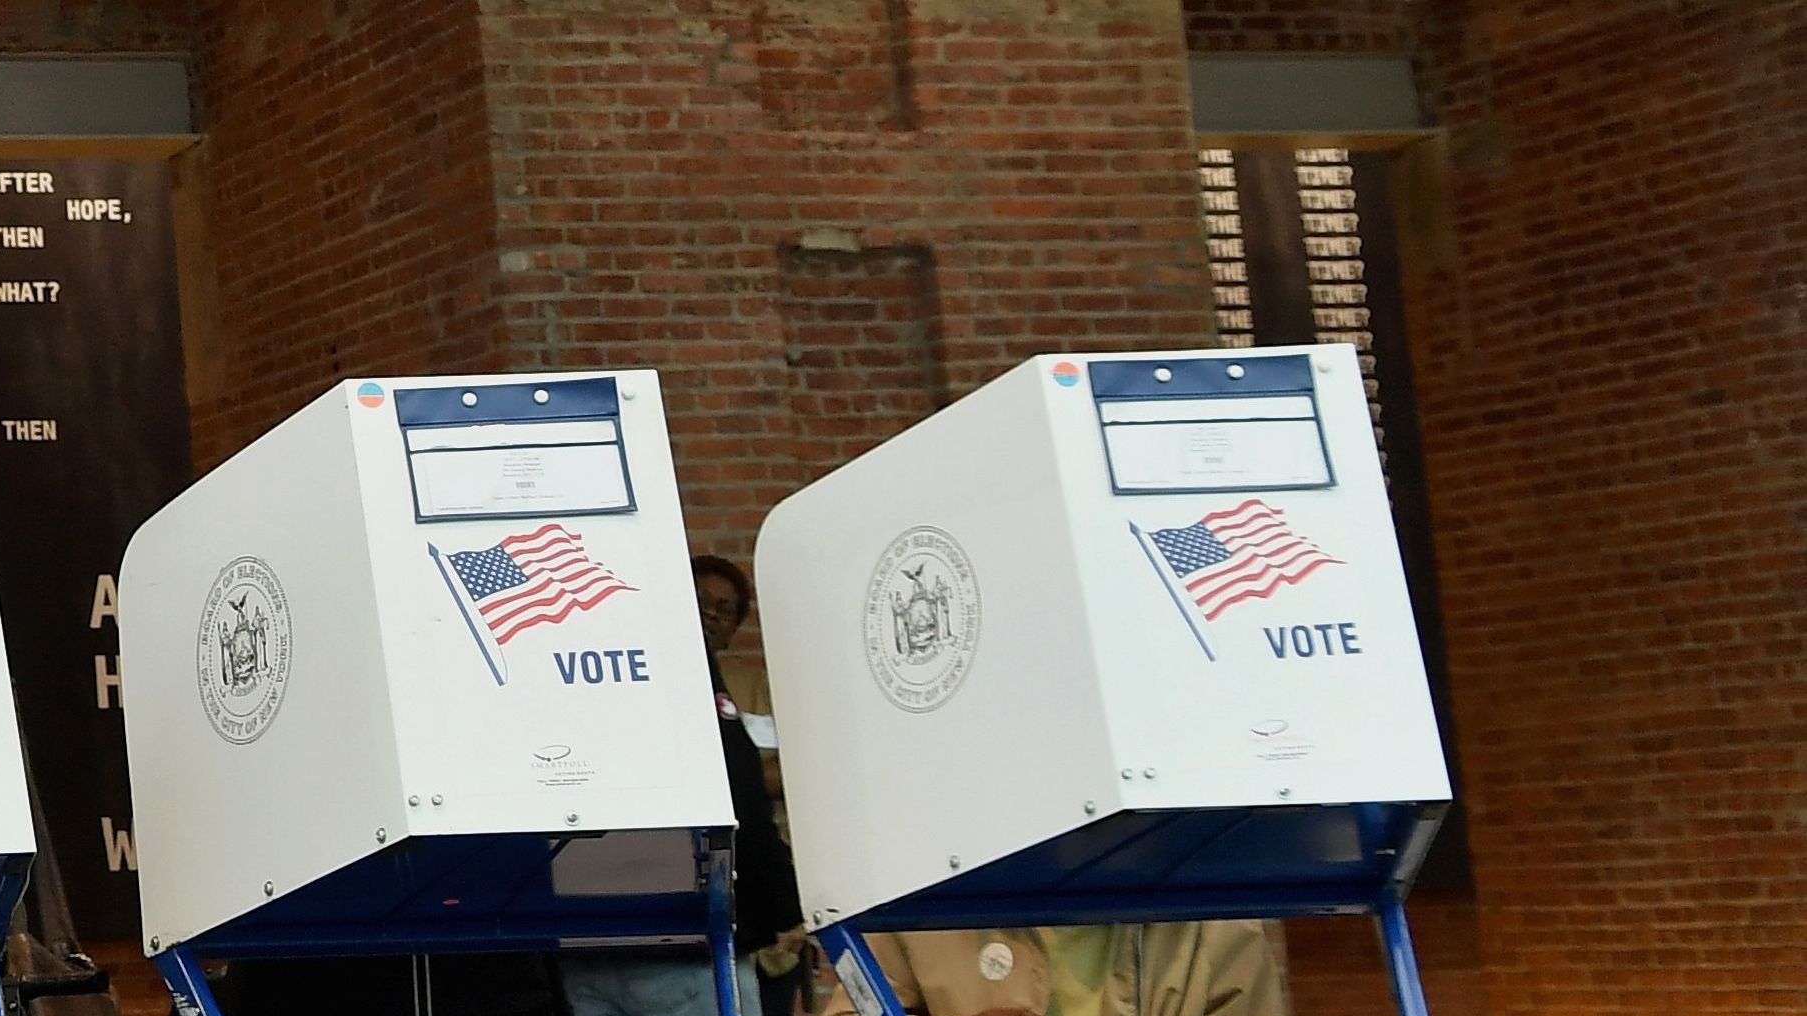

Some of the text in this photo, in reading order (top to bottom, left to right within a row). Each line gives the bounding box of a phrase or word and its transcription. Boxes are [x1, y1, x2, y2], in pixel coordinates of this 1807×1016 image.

[67, 199, 131, 223] HOPE,
[2, 421, 56, 440] THEN
[1264, 623, 1360, 658] VOTE
[554, 650, 649, 684] VOTE
